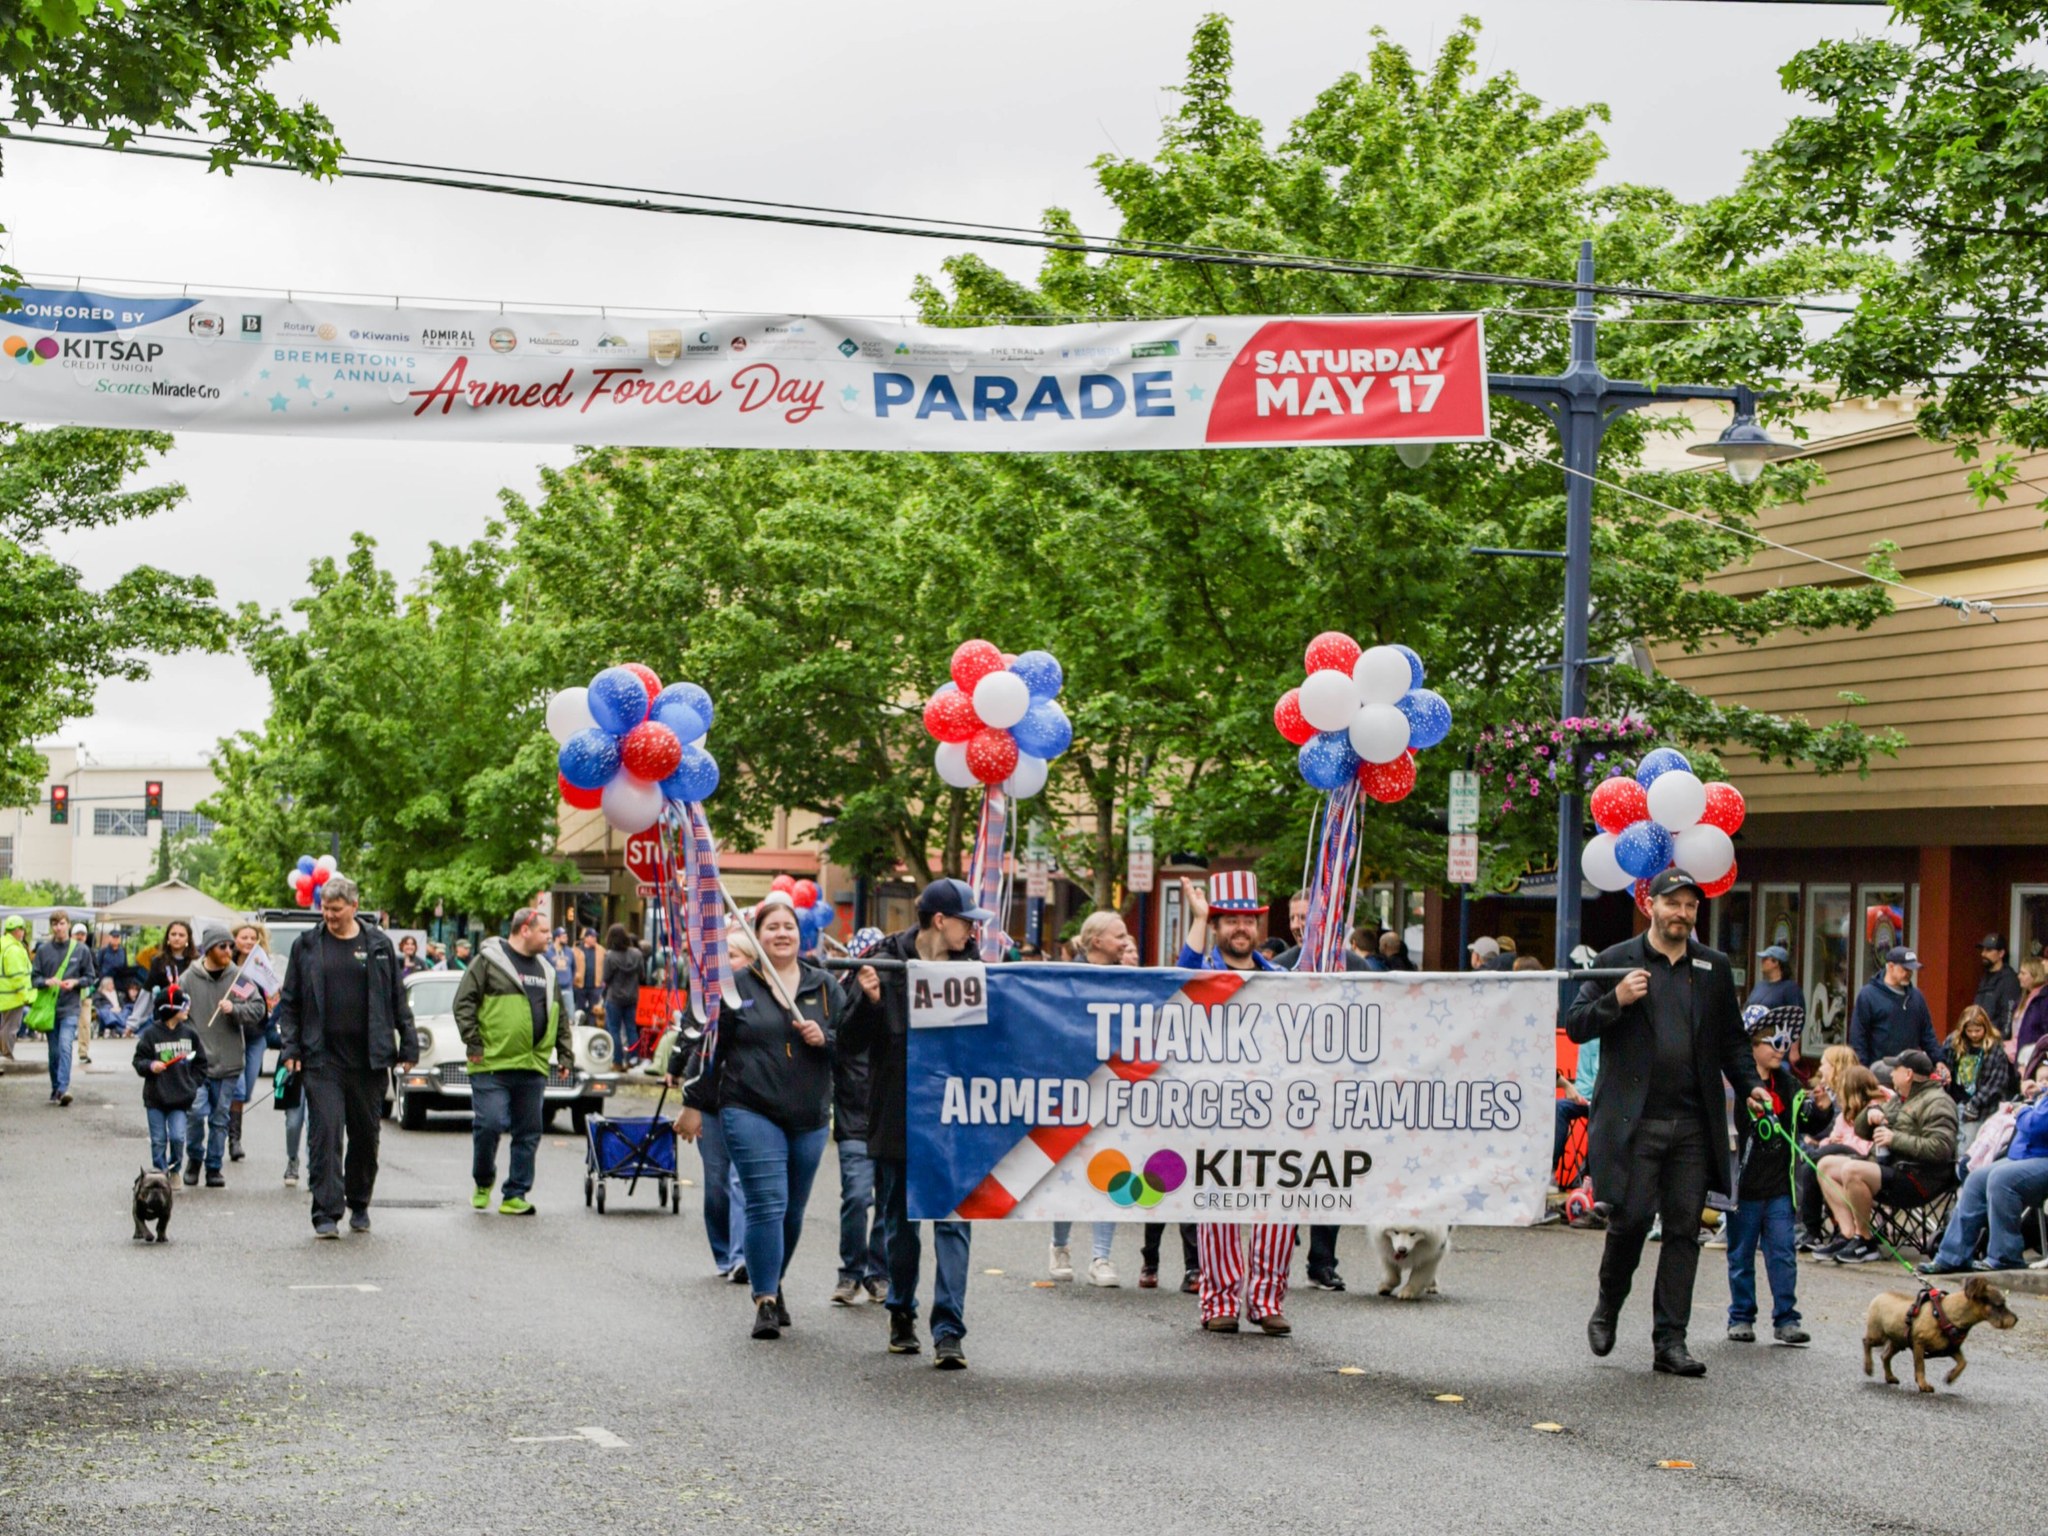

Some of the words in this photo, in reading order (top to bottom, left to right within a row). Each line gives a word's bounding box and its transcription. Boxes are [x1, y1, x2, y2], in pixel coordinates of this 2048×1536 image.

[6, 304, 115, 321] ONSORED
[122, 312, 144, 323] BY
[283, 321, 316, 332] Rotary
[422, 329, 475, 341] ADMIRAL
[362, 330, 410, 343] Kiwanis
[63, 338, 164, 363] KITSAP
[274, 350, 416, 369] BREMERTON'S
[990, 348, 1009, 356] THE
[1012, 348, 1045, 356] TRAILS
[62, 359, 107, 371] CREDIT
[112, 363, 153, 373] UNION
[1255, 347, 1446, 375] SATURDAY
[333, 369, 416, 384] ANNUAL
[95, 378, 151, 396] Scotts
[409, 355, 575, 417] Armed
[580, 368, 722, 414] Forces
[730, 362, 825, 424] Day
[873, 370, 1176, 422] PARADE
[1255, 375, 1377, 417] MAY
[1389, 374, 1446, 414] 17
[913, 975, 983, 1010] A-09
[1086, 1002, 1262, 1063] THANK
[1276, 1003, 1381, 1063] YOU
[940, 1076, 1091, 1127] ARMED
[1105, 1079, 1272, 1128] FORCES
[1286, 1080, 1320, 1128] &
[1333, 1080, 1522, 1130] FAMILIES
[1194, 1149, 1373, 1188] KITSAP
[1193, 1192, 1272, 1209] CREDIT
[1280, 1193, 1352, 1210] UNION
